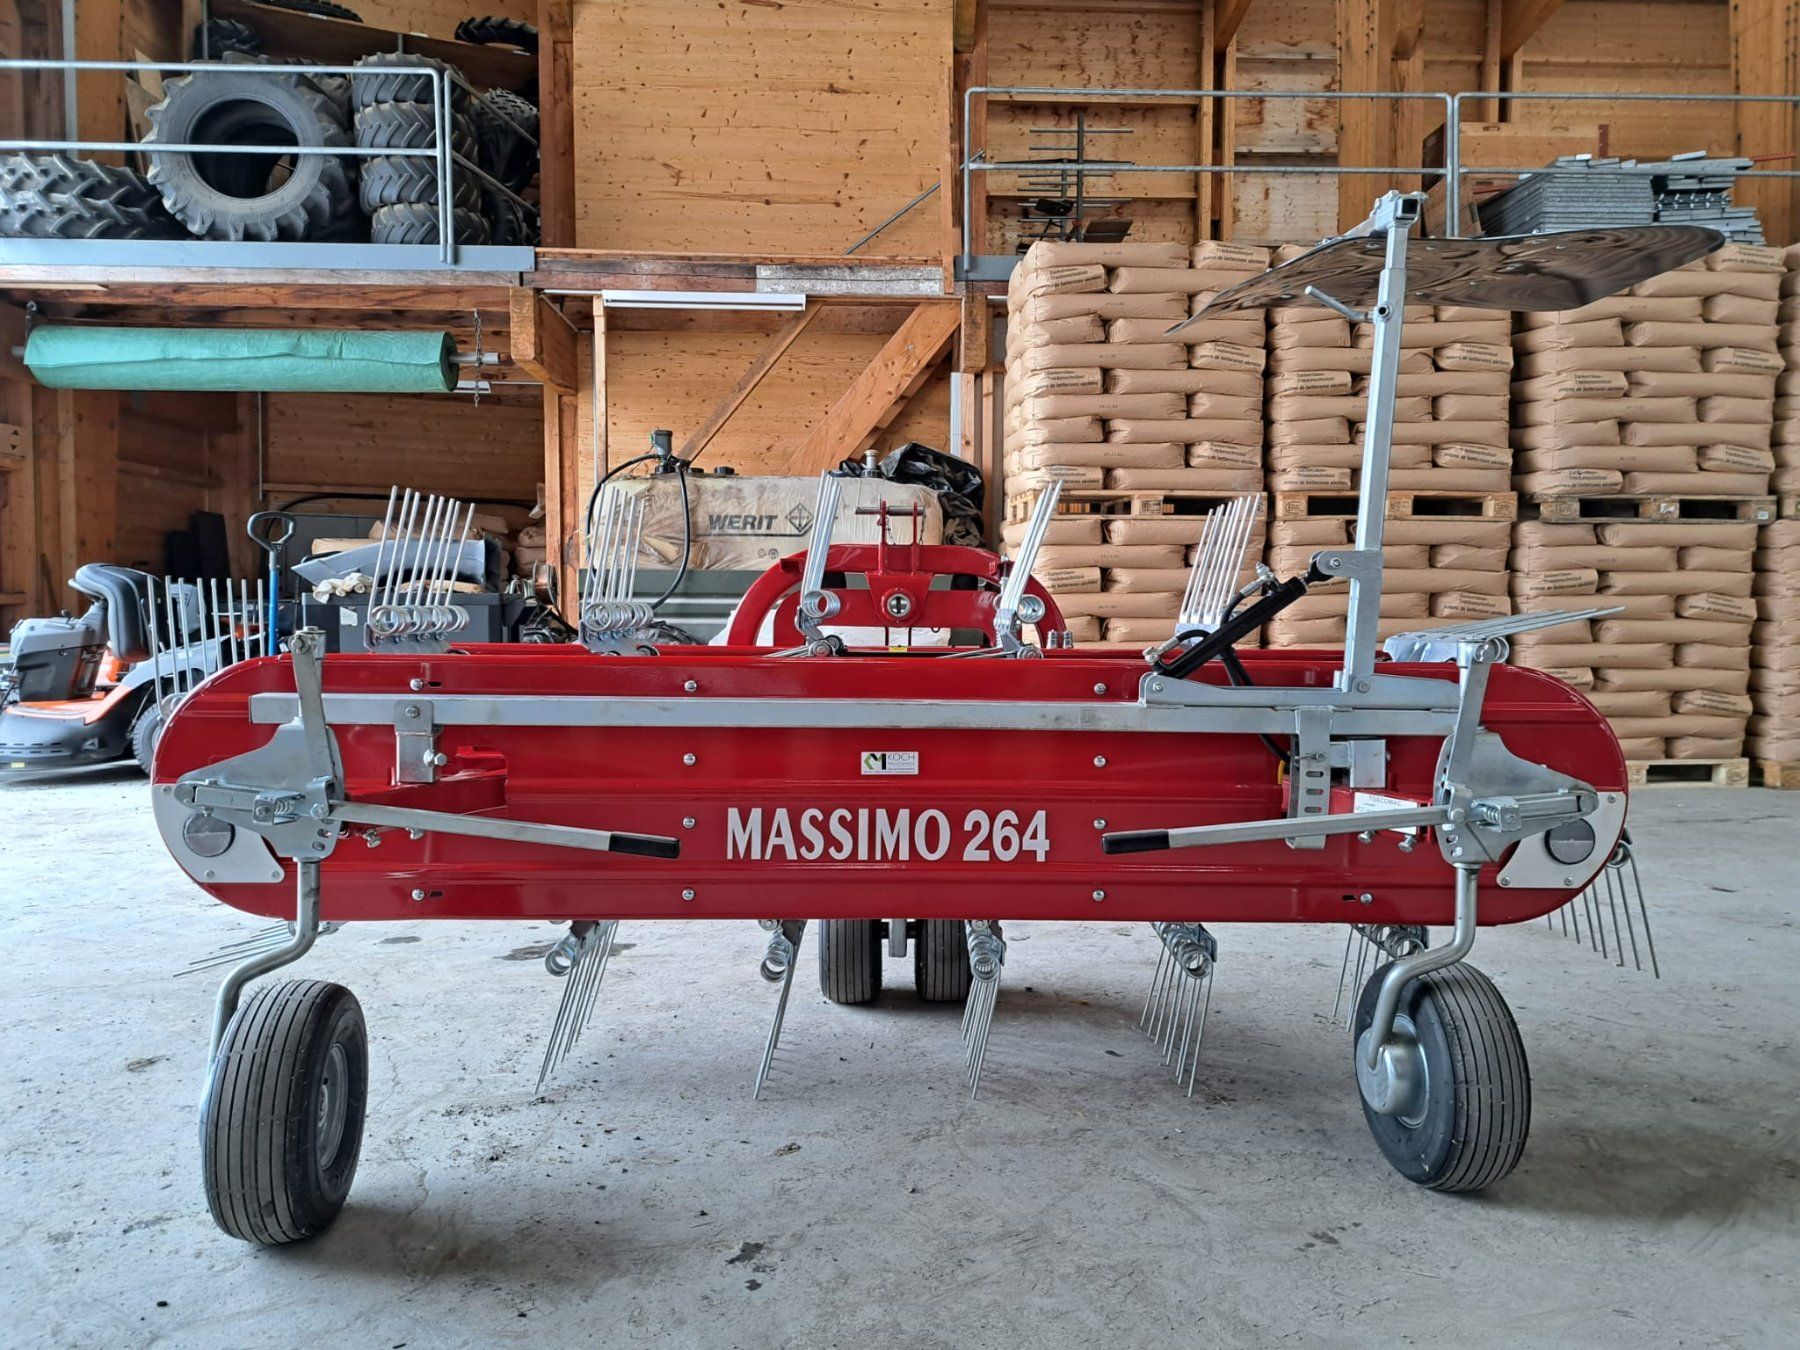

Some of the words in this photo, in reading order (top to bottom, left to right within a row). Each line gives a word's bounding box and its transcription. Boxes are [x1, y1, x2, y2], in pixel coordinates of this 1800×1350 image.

[708, 514, 778, 531] WERIT
[887, 752, 915, 762] KOCH
[726, 806, 951, 862] MASSIMO
[962, 808, 1050, 863] 264
